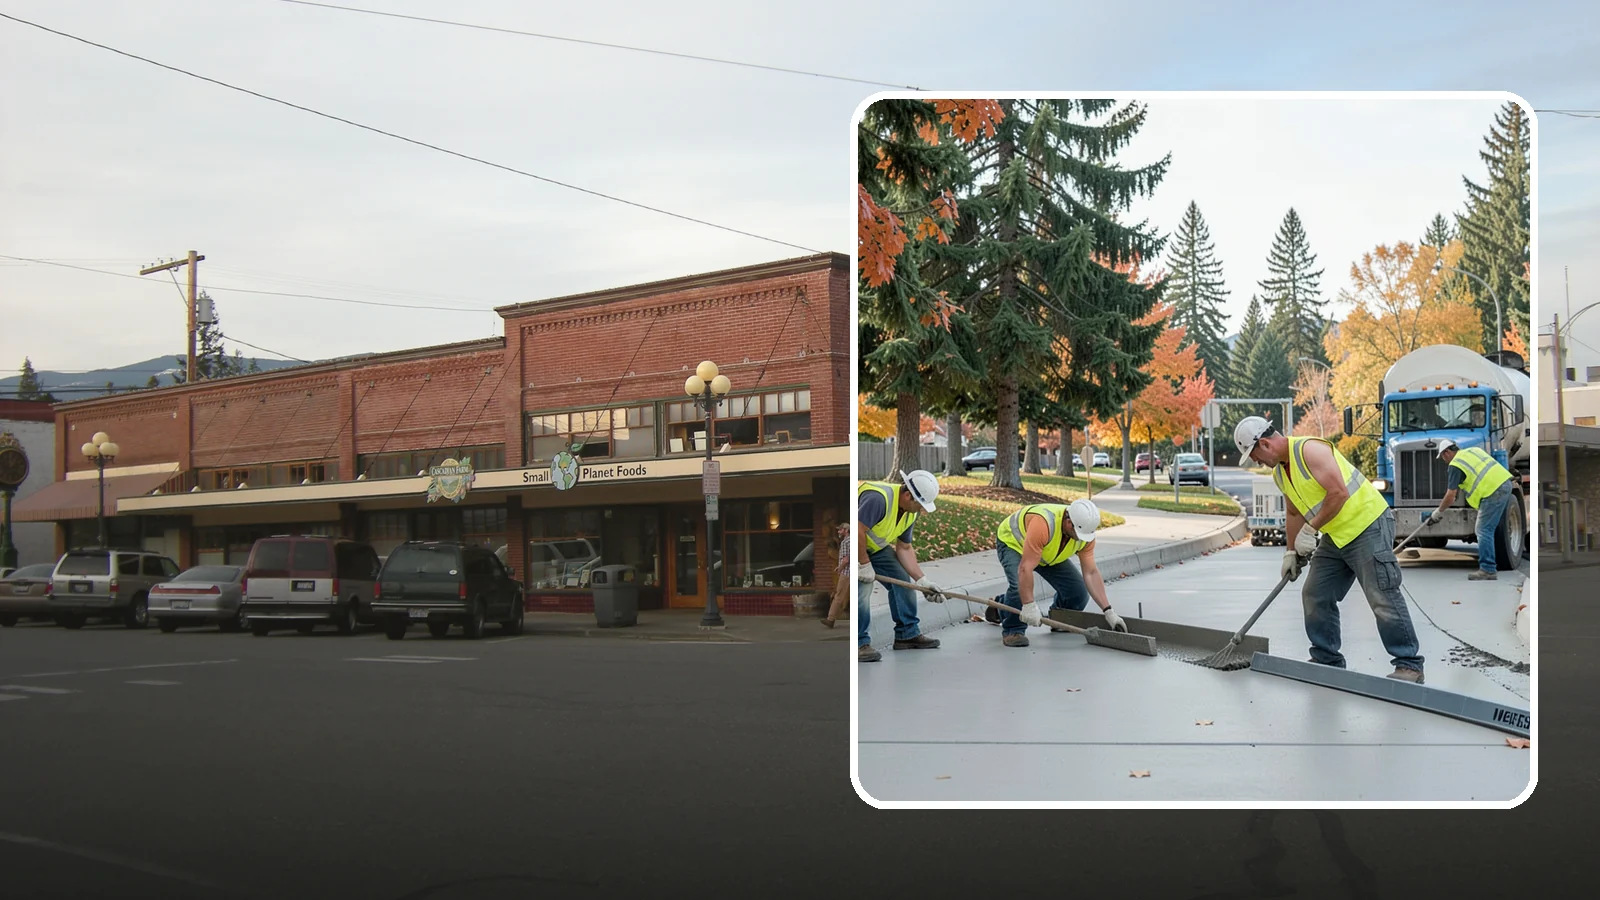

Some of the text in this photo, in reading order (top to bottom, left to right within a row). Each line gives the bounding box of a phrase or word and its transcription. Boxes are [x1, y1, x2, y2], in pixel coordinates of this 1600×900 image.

[523, 464, 647, 482] Small Planet Foods
